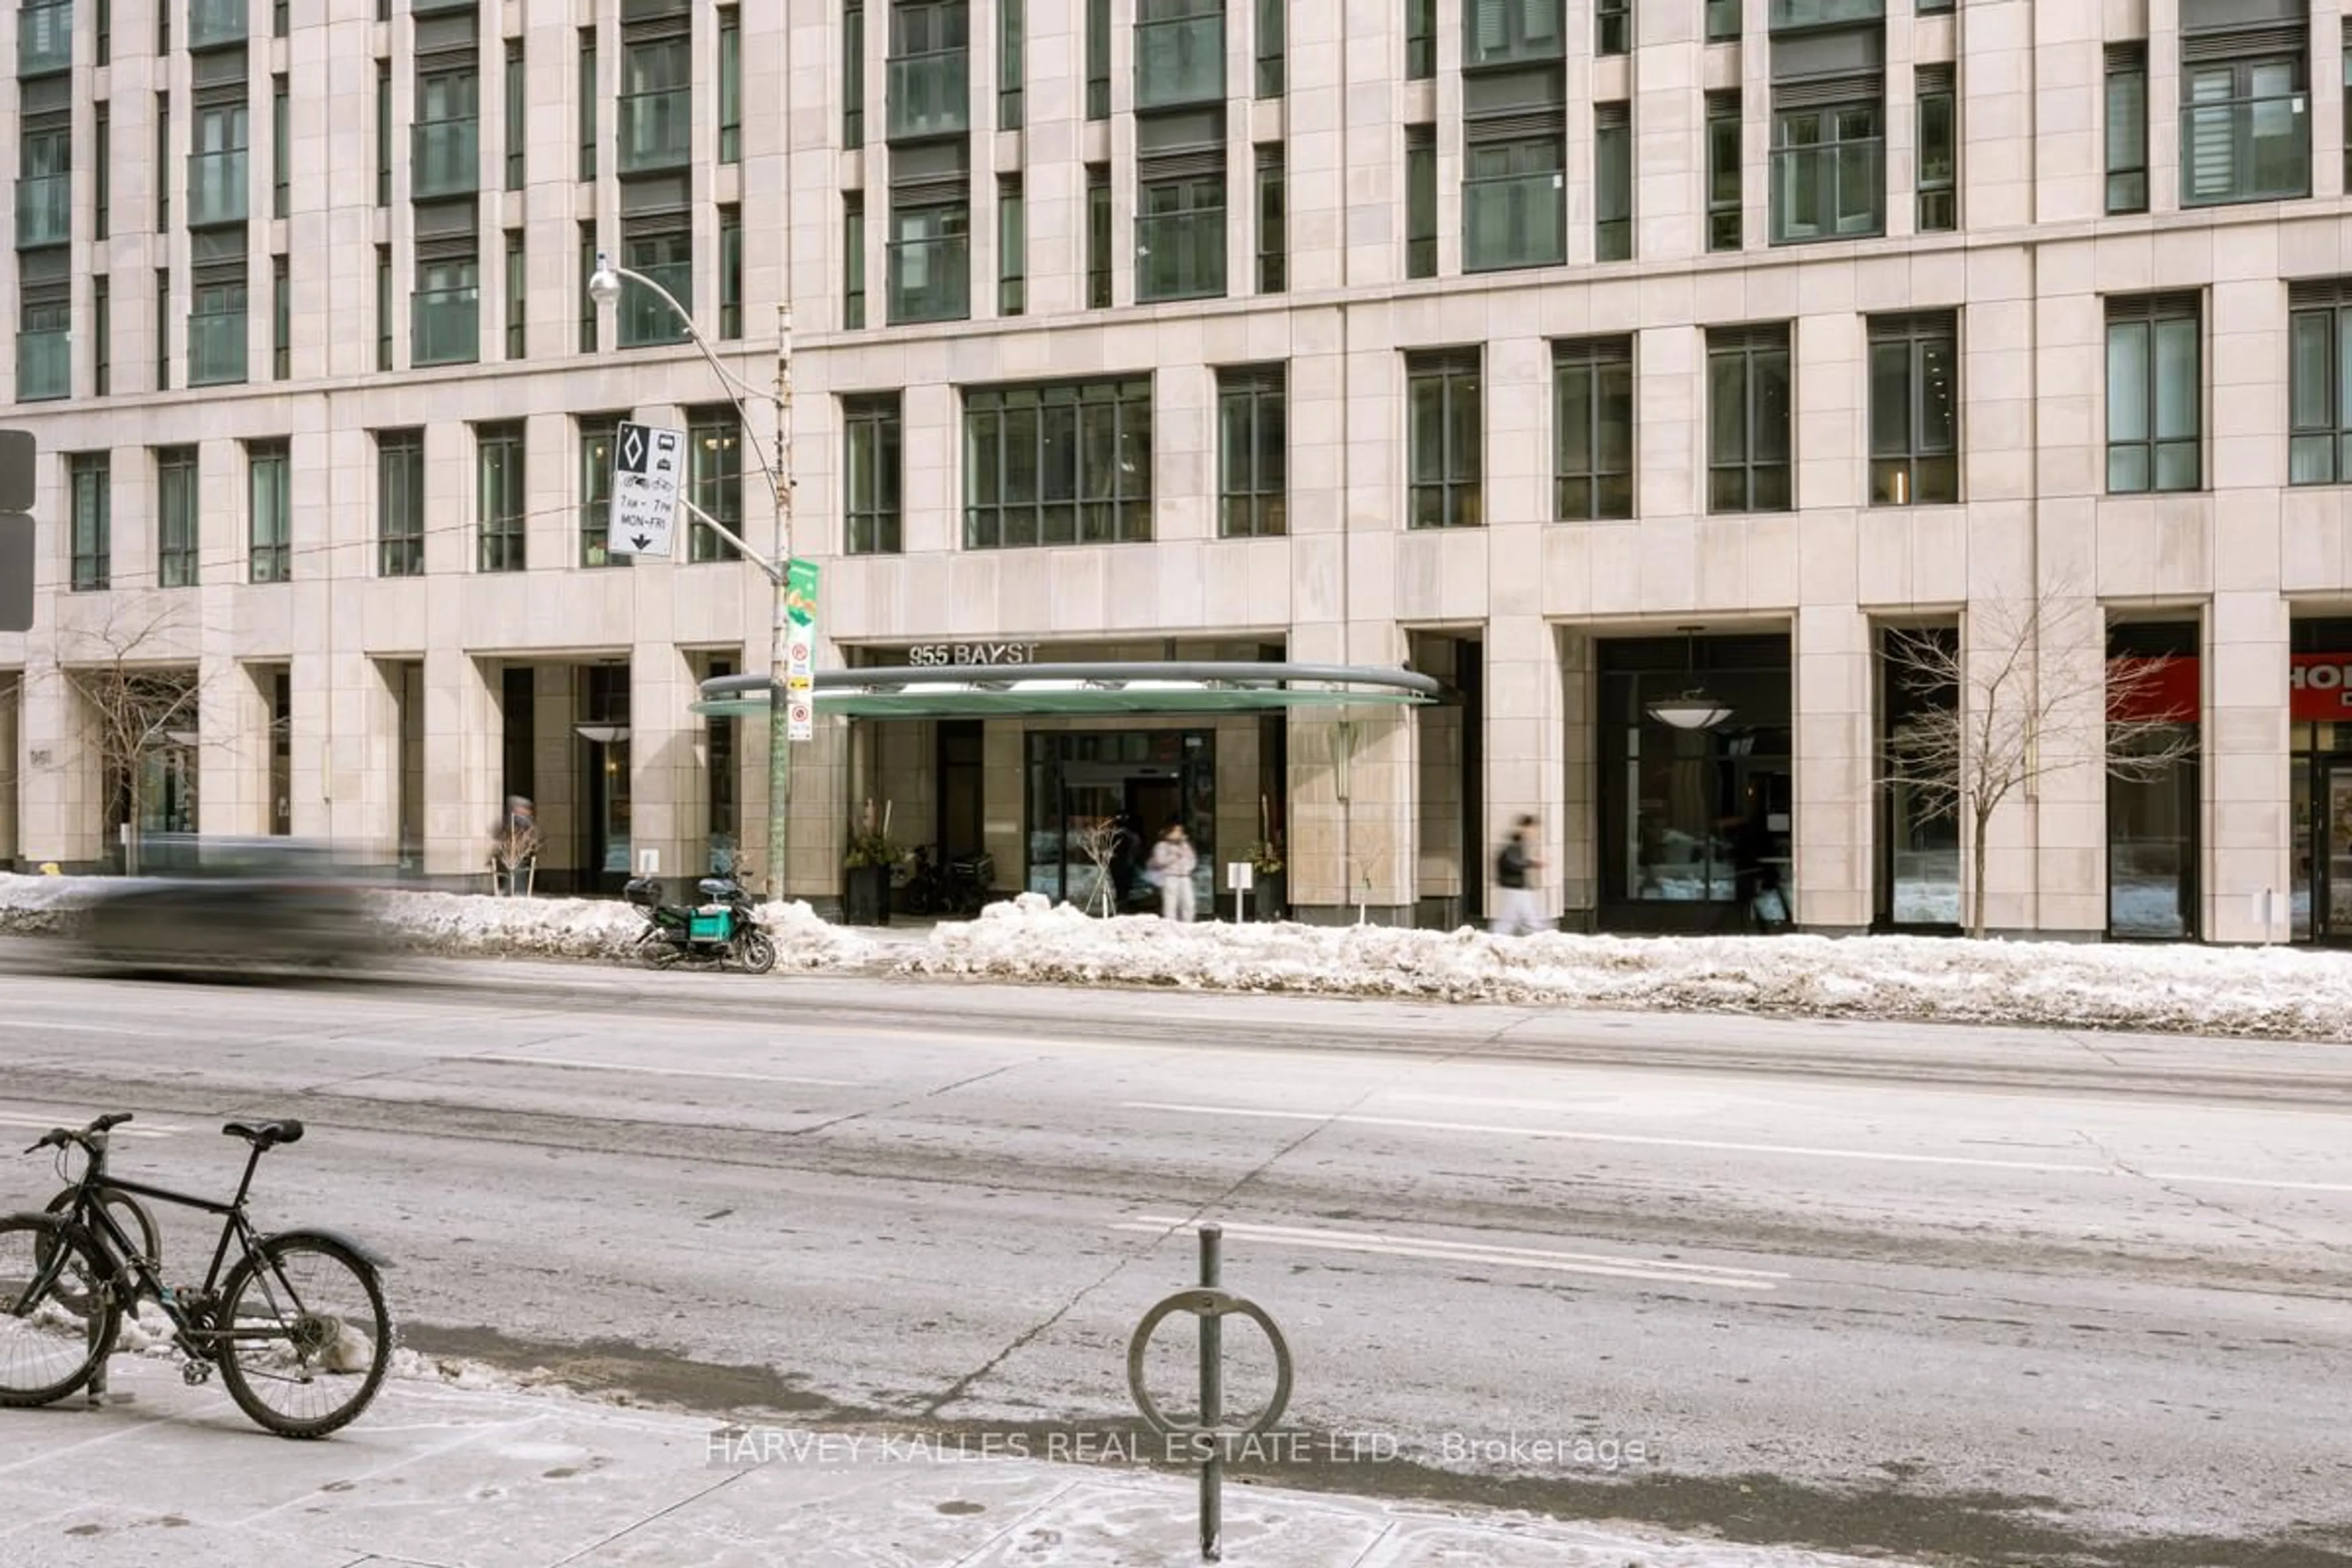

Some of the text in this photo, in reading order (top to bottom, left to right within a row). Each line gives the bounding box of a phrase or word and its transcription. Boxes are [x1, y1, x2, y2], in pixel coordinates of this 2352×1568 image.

[910, 643, 1039, 666] 955 BAY ST
